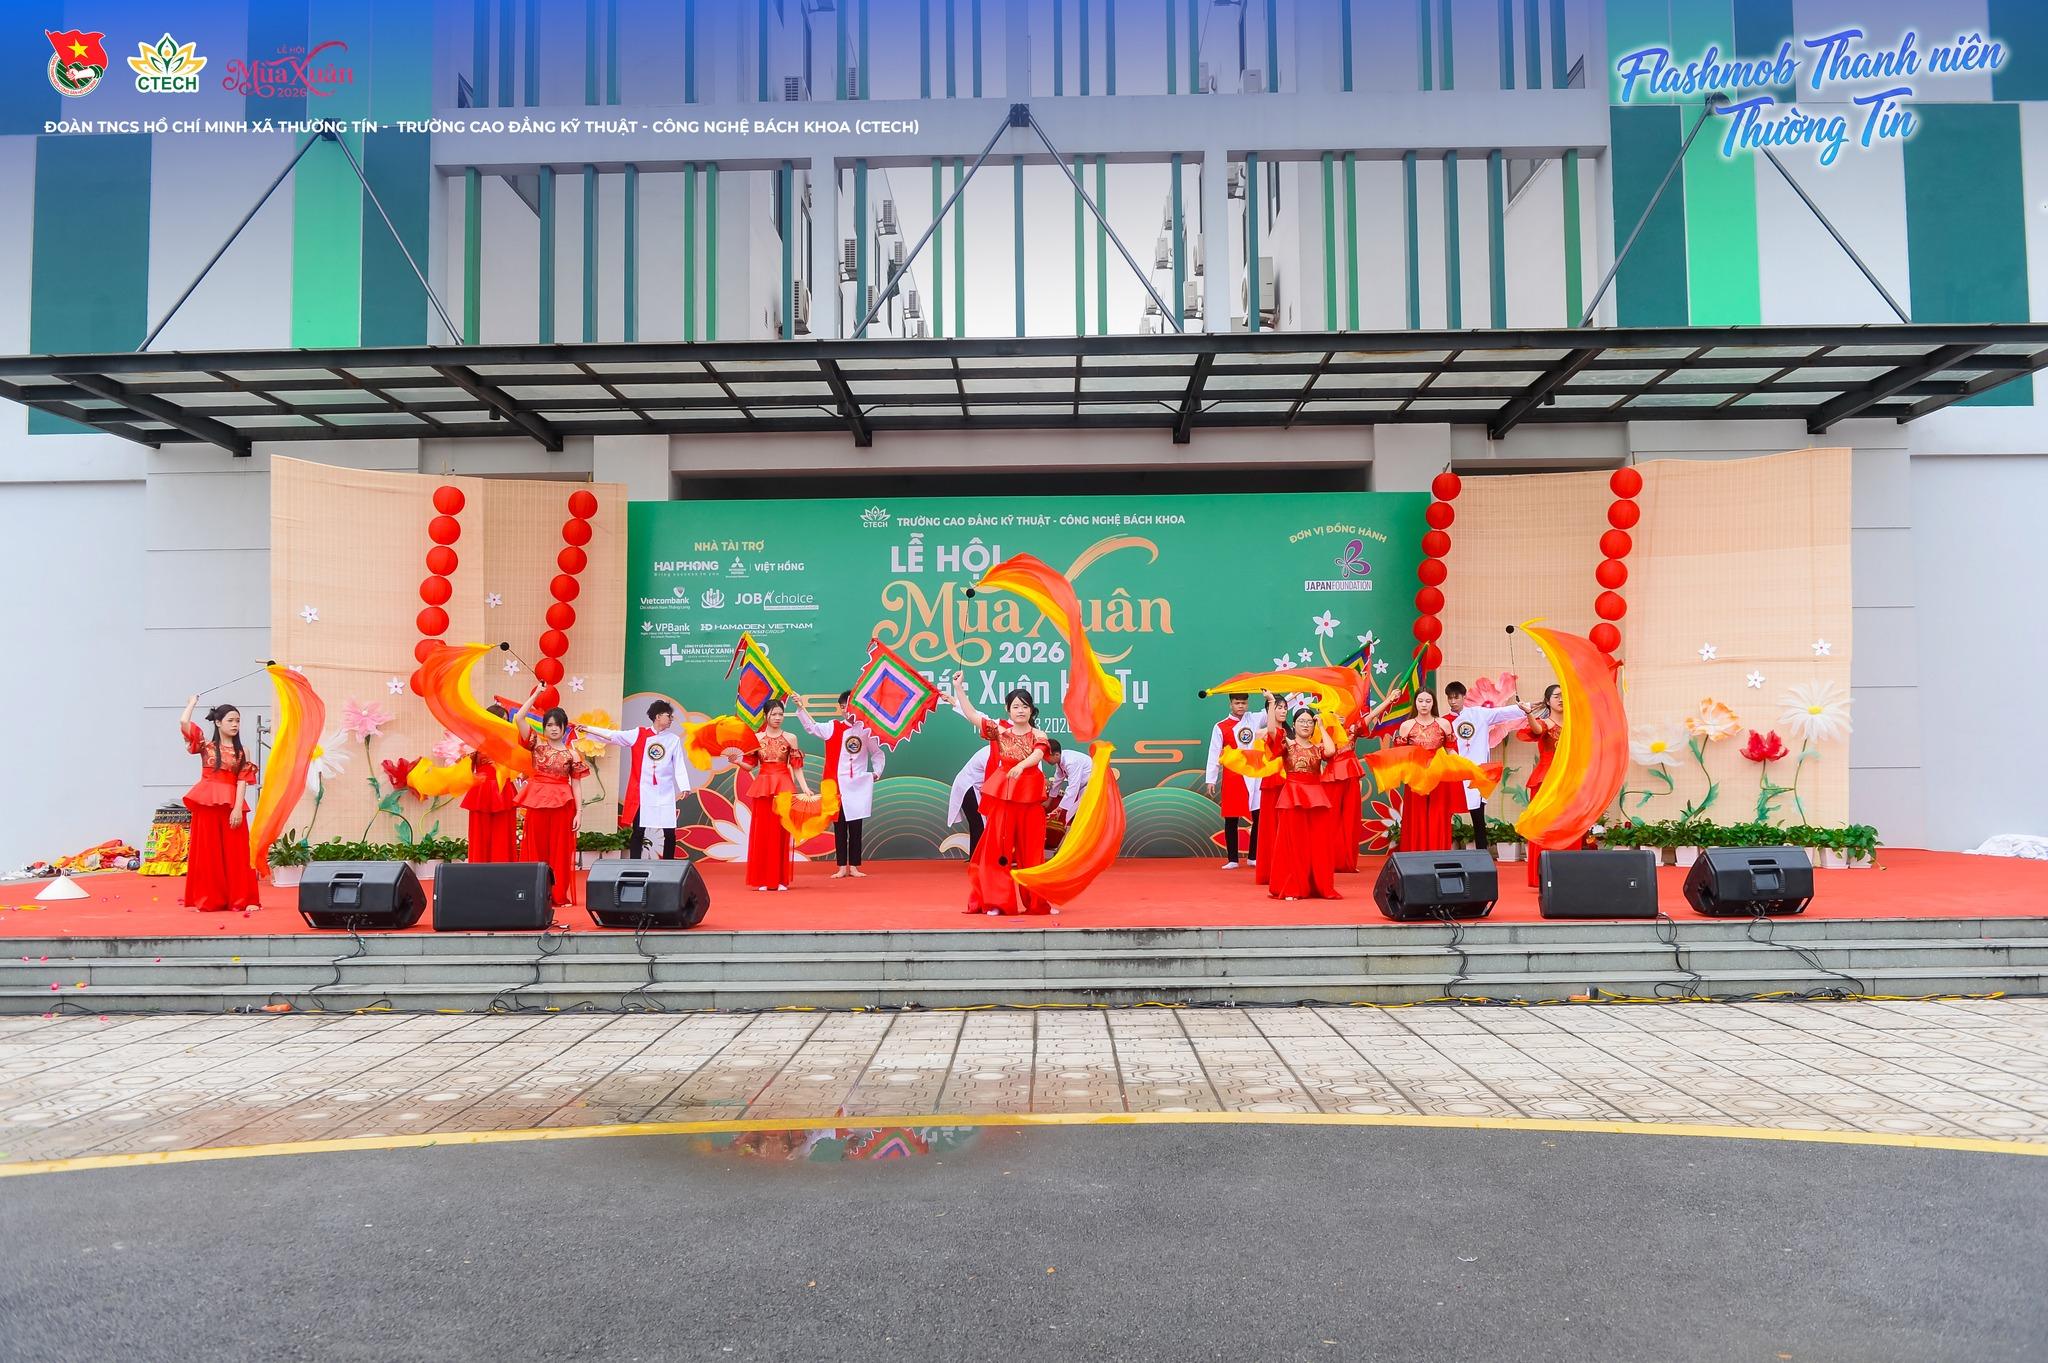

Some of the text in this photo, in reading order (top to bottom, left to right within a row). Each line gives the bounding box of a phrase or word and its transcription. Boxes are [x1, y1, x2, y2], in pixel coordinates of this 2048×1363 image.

[897, 515, 941, 527] TRƯỜNG
[943, 516, 966, 526] CAO
[967, 513, 998, 526] ĐẲNG
[1000, 514, 1015, 526] KỸ
[1015, 514, 1051, 528] THUẬT
[1059, 514, 1090, 526] CÔNG
[1091, 514, 1121, 527] NGHỆ
[1123, 514, 1153, 525] BÁCH
[1155, 515, 1186, 525] KHOA
[1289, 529, 1313, 544] ĐƠN
[1313, 526, 1324, 536] VỊ
[1358, 527, 1388, 543] HÀNH
[694, 539, 765, 553] NHÀ TÀI TRỢ
[890, 532, 1002, 580] LỄ HỘI
[654, 560, 719, 572] HAI PHONG
[754, 561, 776, 573] VIỆT
[640, 597, 690, 605] Vietcombank
[735, 592, 814, 605] JOB choice
[655, 622, 690, 632] VPBank
[768, 622, 813, 630] VIETNAM
[999, 642, 1065, 664] 2026
[1114, 669, 1149, 710] Tụ
